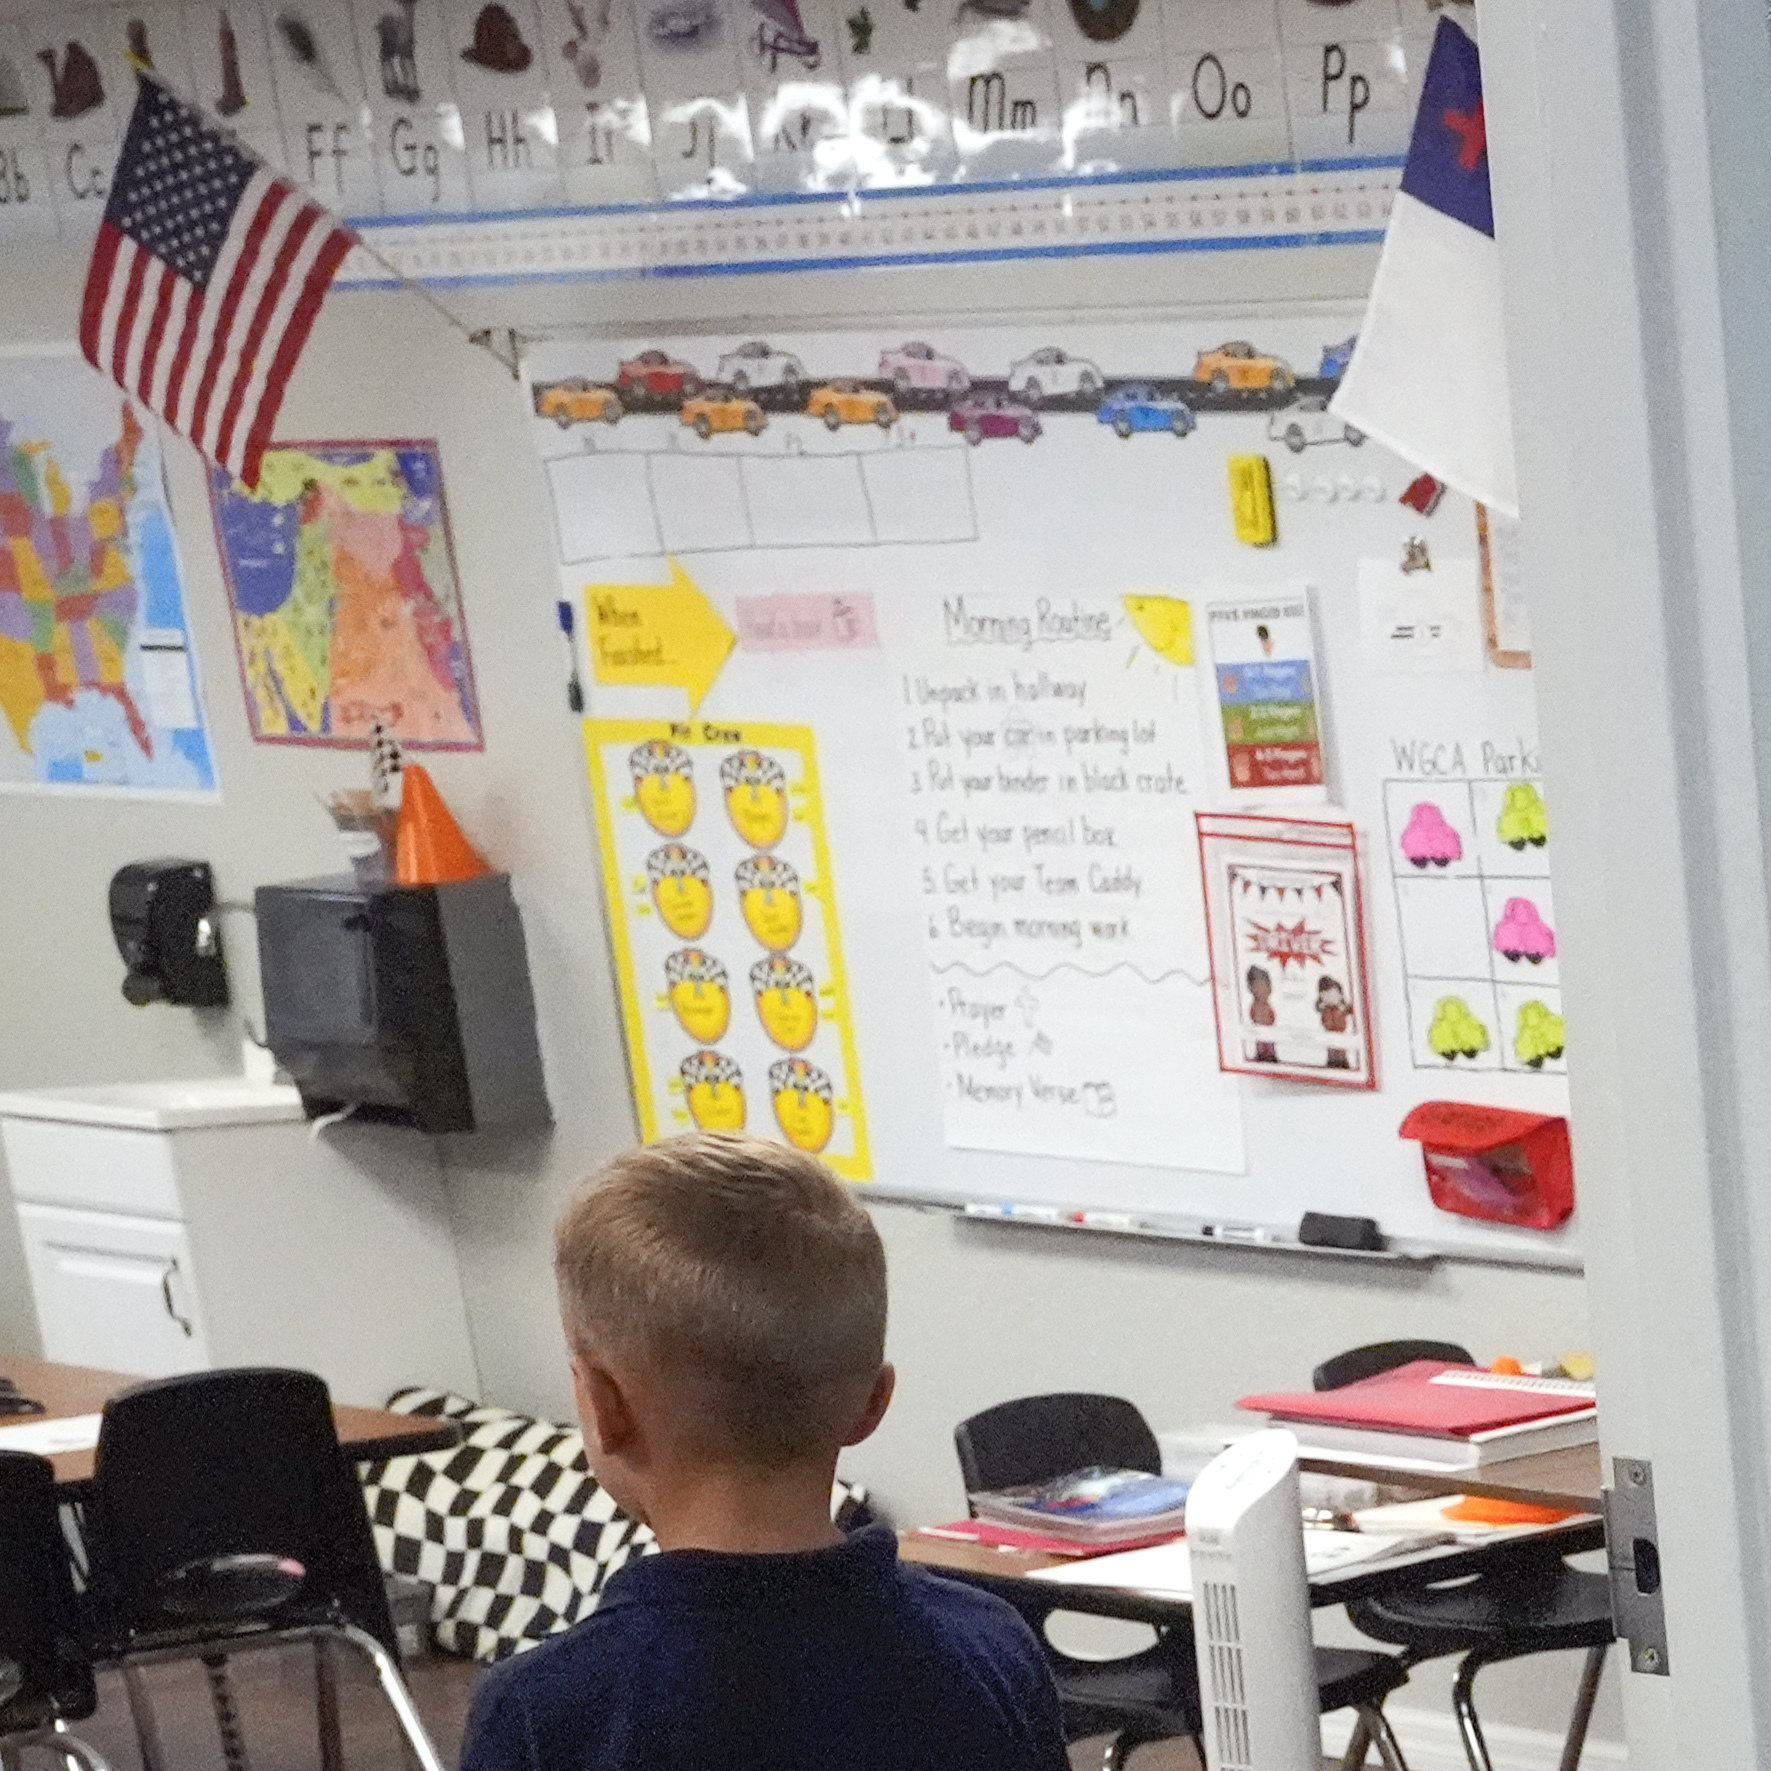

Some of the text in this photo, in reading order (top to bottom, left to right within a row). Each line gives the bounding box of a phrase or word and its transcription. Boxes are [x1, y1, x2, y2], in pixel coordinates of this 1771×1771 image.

[390, 117, 441, 203] Gg
[967, 71, 1037, 133] Mm
[1192, 52, 1253, 120] Oo
[1321, 43, 1371, 144] Pp
[942, 595, 1110, 653] Morning Routine
[1011, 669, 1087, 707] hallway
[1062, 718, 1130, 756] parking
[1136, 762, 1188, 794] crate
[936, 809, 970, 844] Get
[942, 860, 979, 895] Get
[1034, 863, 1080, 896] Team
[947, 903, 1007, 949] Begin
[947, 985, 1007, 1029] Prayer
[952, 1030, 1015, 1071] Pledge
[1027, 1074, 1080, 1105] Verse
